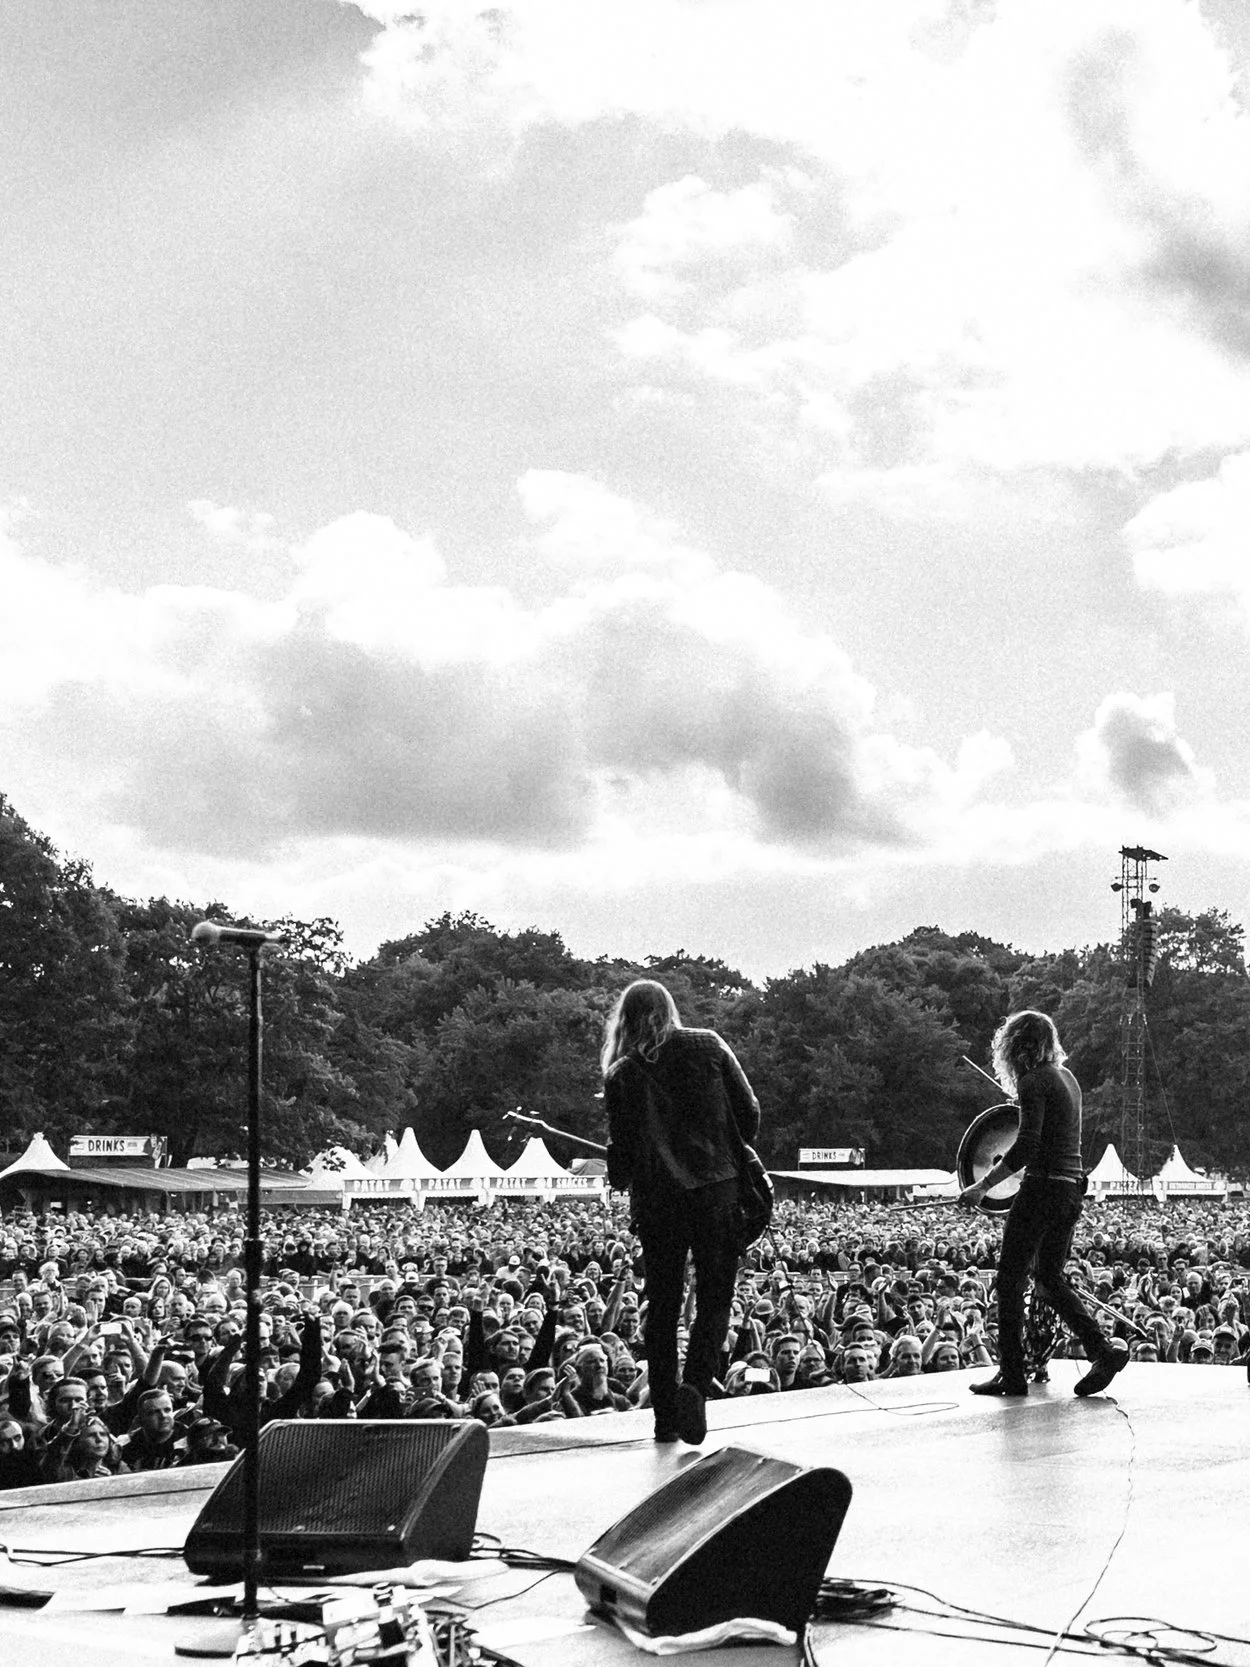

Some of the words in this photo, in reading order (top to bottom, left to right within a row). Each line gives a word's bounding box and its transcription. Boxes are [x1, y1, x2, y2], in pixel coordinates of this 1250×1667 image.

[88, 1140, 125, 1151] DRINKS
[812, 1151, 837, 1160] DRINKS
[353, 1180, 391, 1192] PATAT
[427, 1179, 462, 1190] PATAT
[496, 1178, 527, 1188] PATAT
